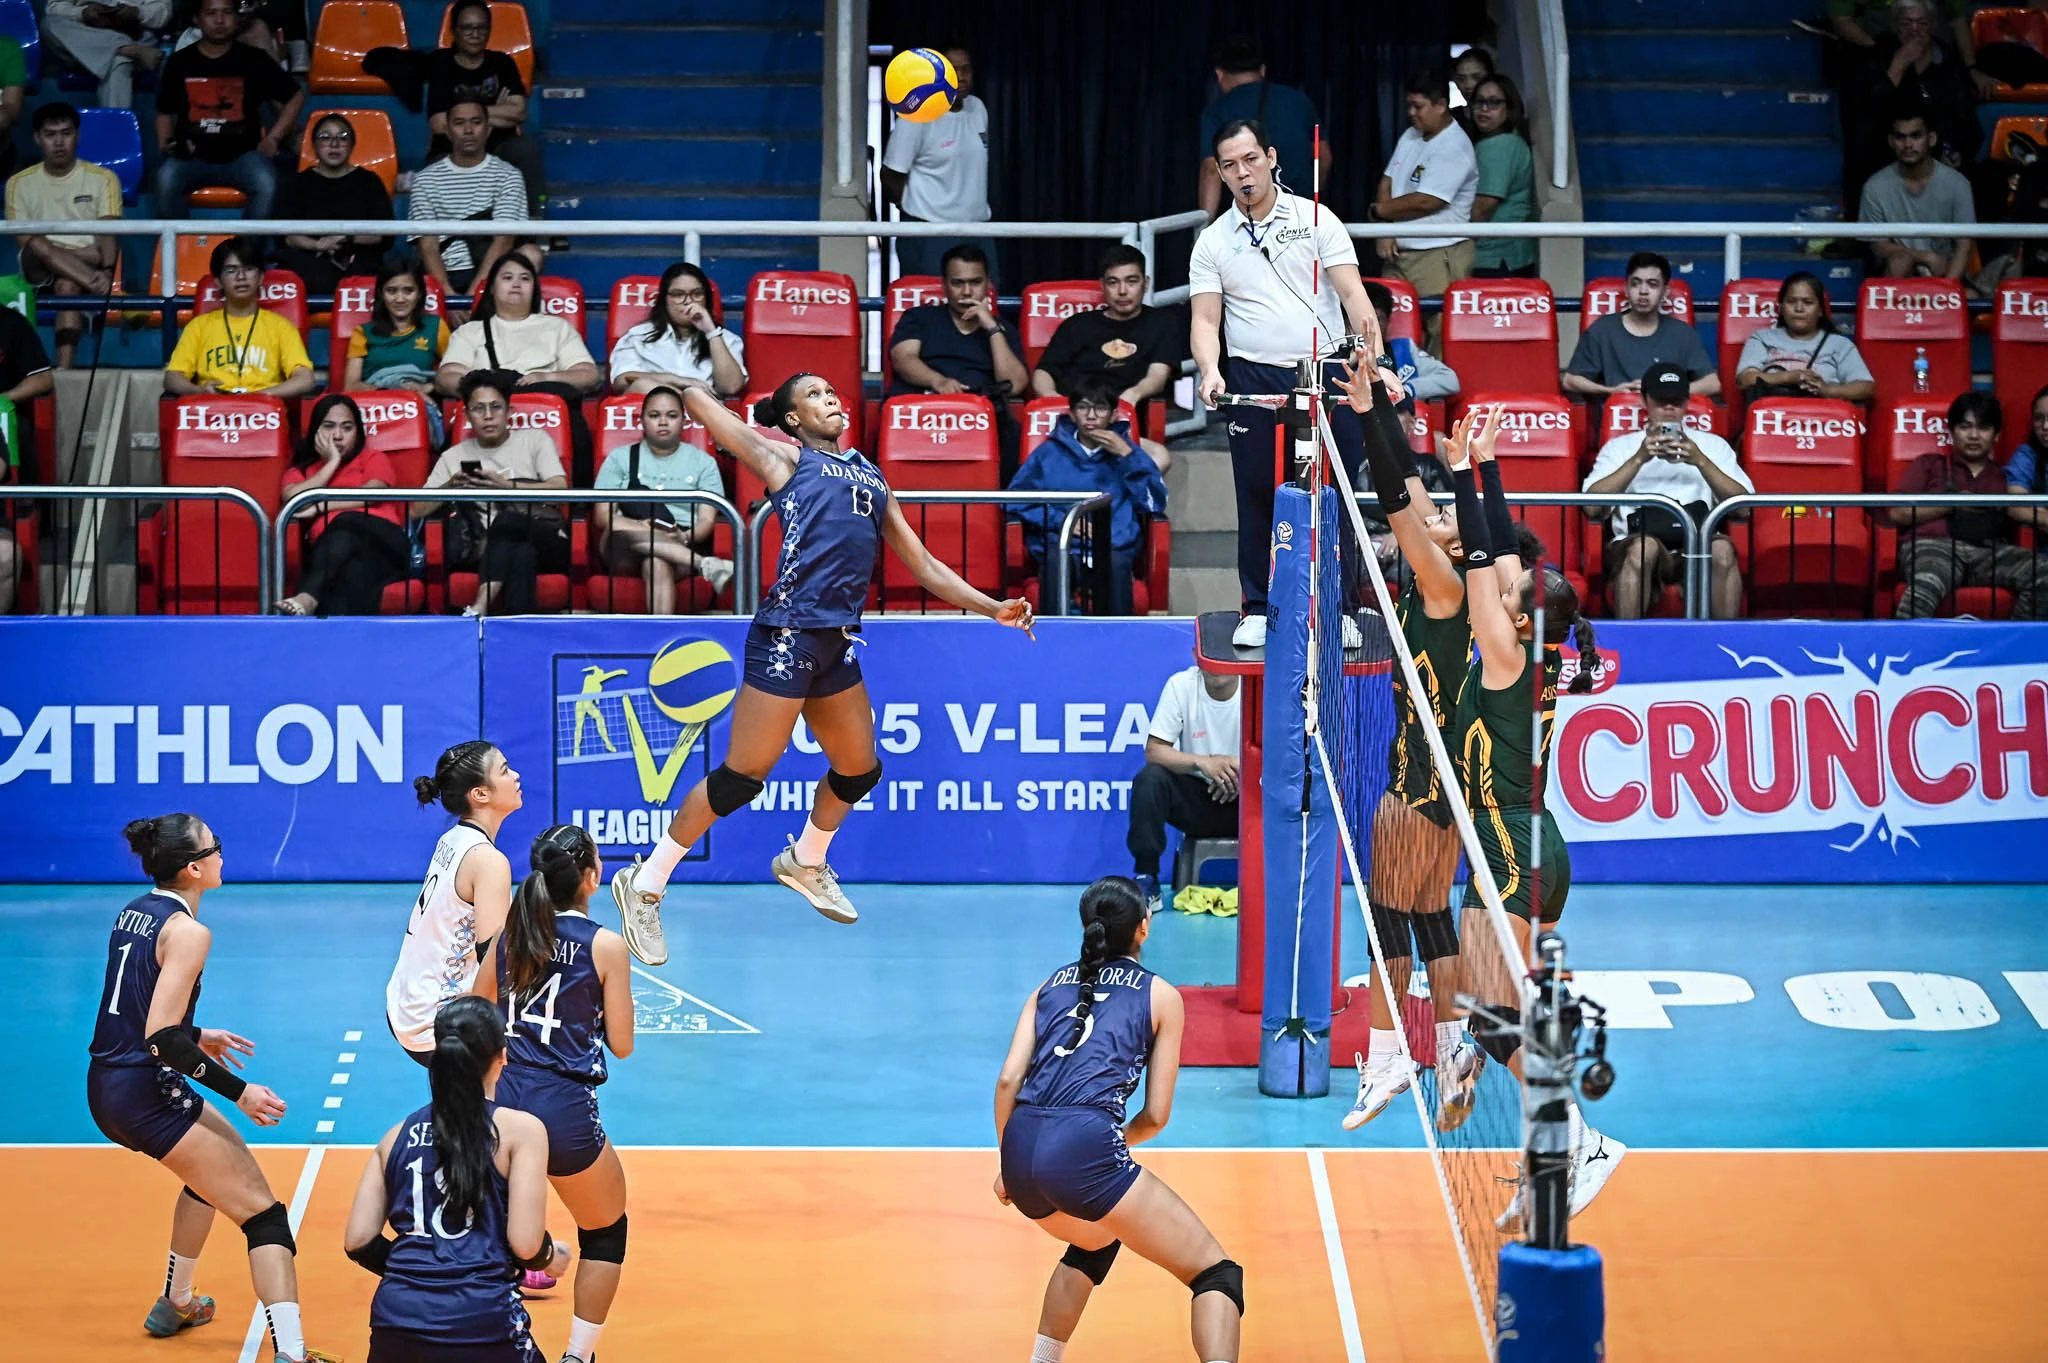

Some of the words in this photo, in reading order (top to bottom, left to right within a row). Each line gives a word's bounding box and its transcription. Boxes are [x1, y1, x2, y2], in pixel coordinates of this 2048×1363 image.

[755, 277, 851, 305] Hanes
[1451, 291, 1550, 315] Hanes
[1868, 286, 1960, 310] Hanes
[791, 304, 806, 317] 17
[1493, 315, 1511, 327] 21
[1905, 313, 1922, 324] 24
[177, 403, 280, 431] Hanes
[889, 405, 989, 430] Hanes
[1753, 410, 1856, 436] Hanes
[221, 431, 240, 443] 13
[930, 433, 947, 445] 18
[1511, 430, 1529, 442] 21
[1796, 438, 1816, 450] 23
[850, 485, 872, 517] 13
[1557, 681, 2048, 823] CRUNCH
[888, 780, 923, 811] IT
[938, 780, 1003, 811] ALL
[572, 809, 678, 845] EAGU
[108, 942, 133, 1015] 1
[1051, 966, 1080, 987] DEL
[1094, 967, 1145, 989] ORAL
[504, 972, 562, 1045] 14
[1054, 992, 1110, 1057] 5
